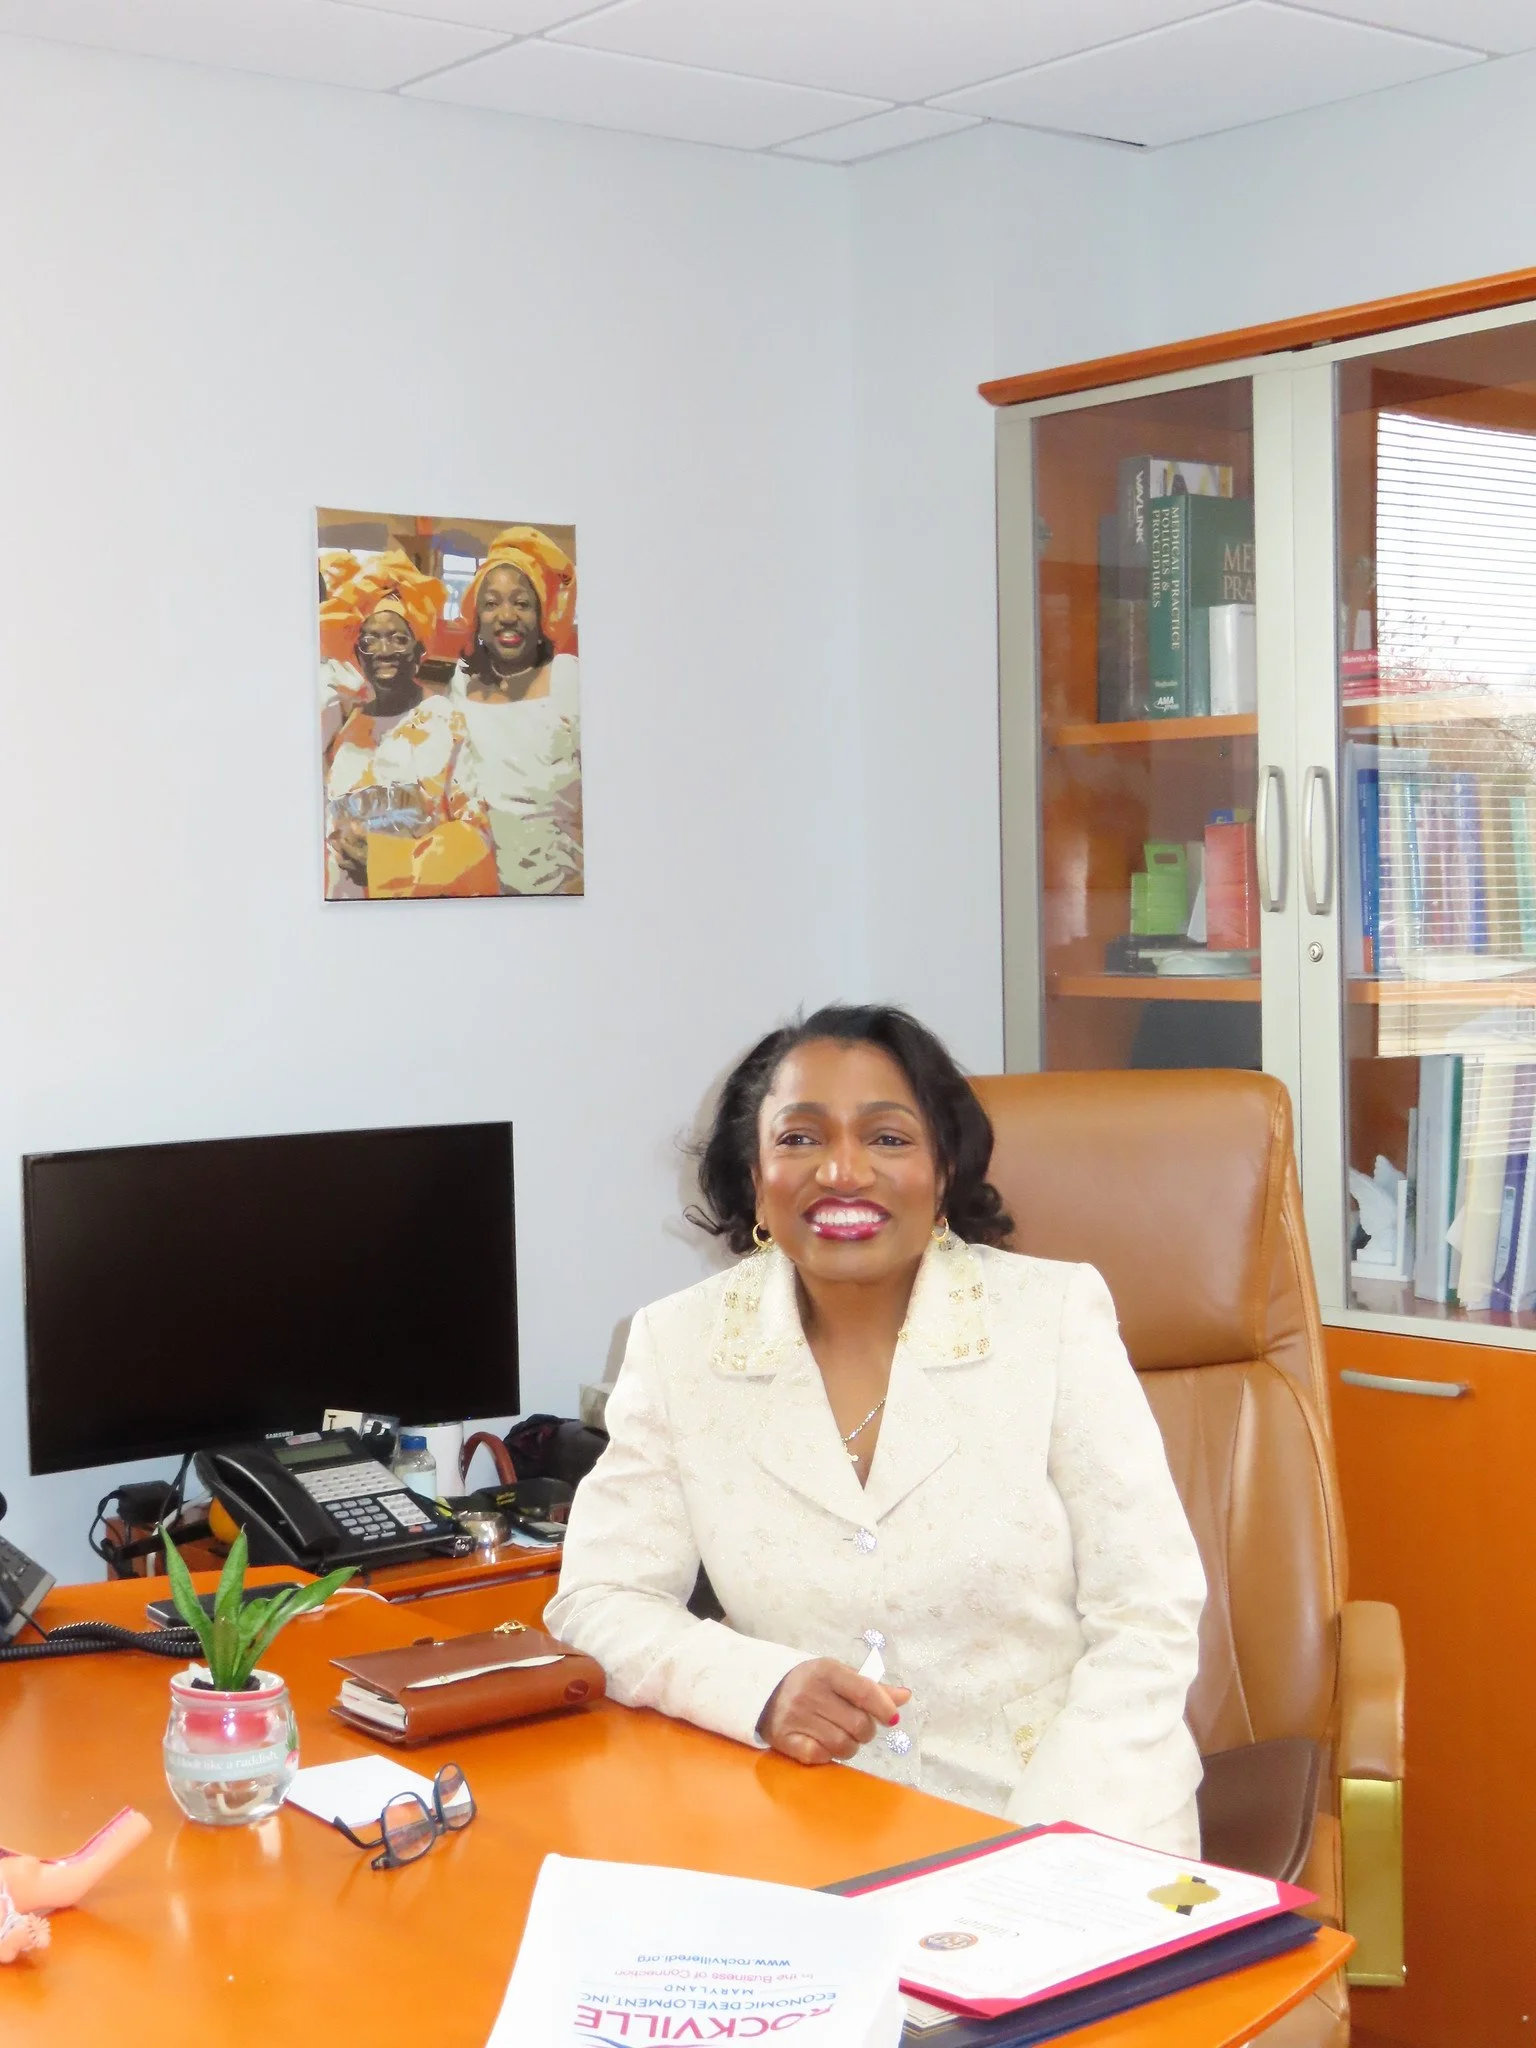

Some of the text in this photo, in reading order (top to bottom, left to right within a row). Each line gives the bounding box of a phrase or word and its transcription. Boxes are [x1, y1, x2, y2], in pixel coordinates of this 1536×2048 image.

[1136, 470, 1144, 543] WAVLINK
[1162, 509, 1170, 591] POLICIES &
[1152, 509, 1161, 608] PROCEDURES
[1171, 507, 1180, 649] MEDICAL PRACTICE
[1157, 696, 1175, 705] AMA
[637, 1954, 791, 1967] www.rockvilleredi.org
[614, 1967, 691, 1979] Connection
[694, 1970, 708, 1979] of
[711, 1971, 773, 1984] Business
[664, 1984, 754, 1996] MARYLAND
[744, 1992, 837, 2010] ECONOMIC
[574, 2003, 836, 2039] ROCKVILLE
